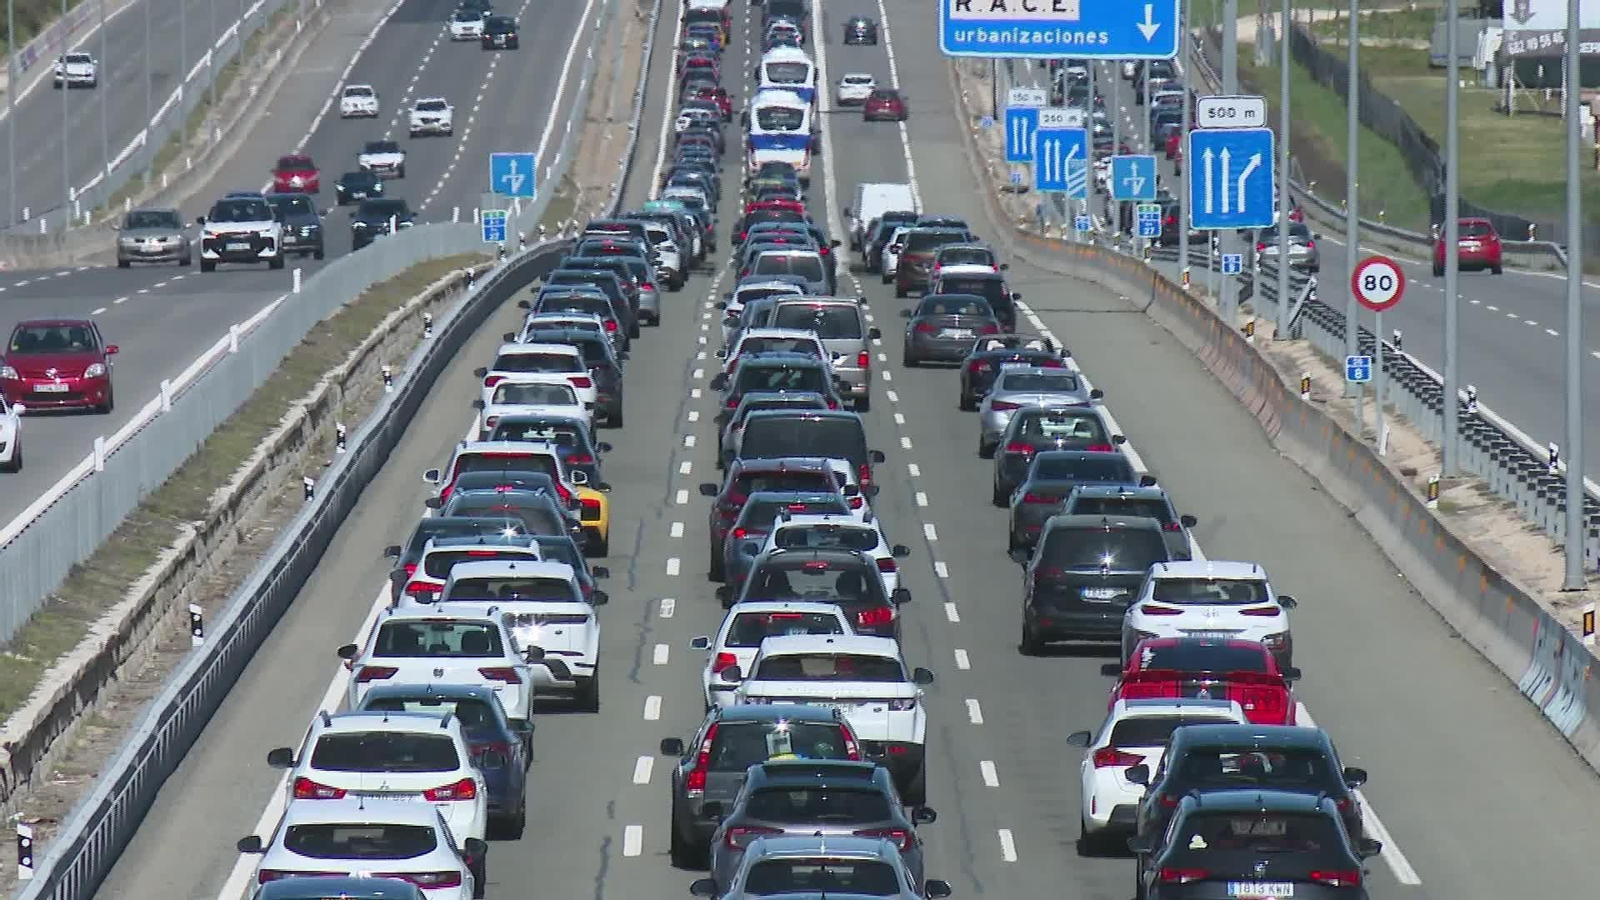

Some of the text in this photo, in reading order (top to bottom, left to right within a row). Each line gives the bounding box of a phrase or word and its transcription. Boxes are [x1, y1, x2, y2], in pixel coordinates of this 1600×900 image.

[955, 28, 1108, 44] urbanizaciones
[1208, 106, 1256, 118] 500 m
[1364, 275, 1393, 291] 80
